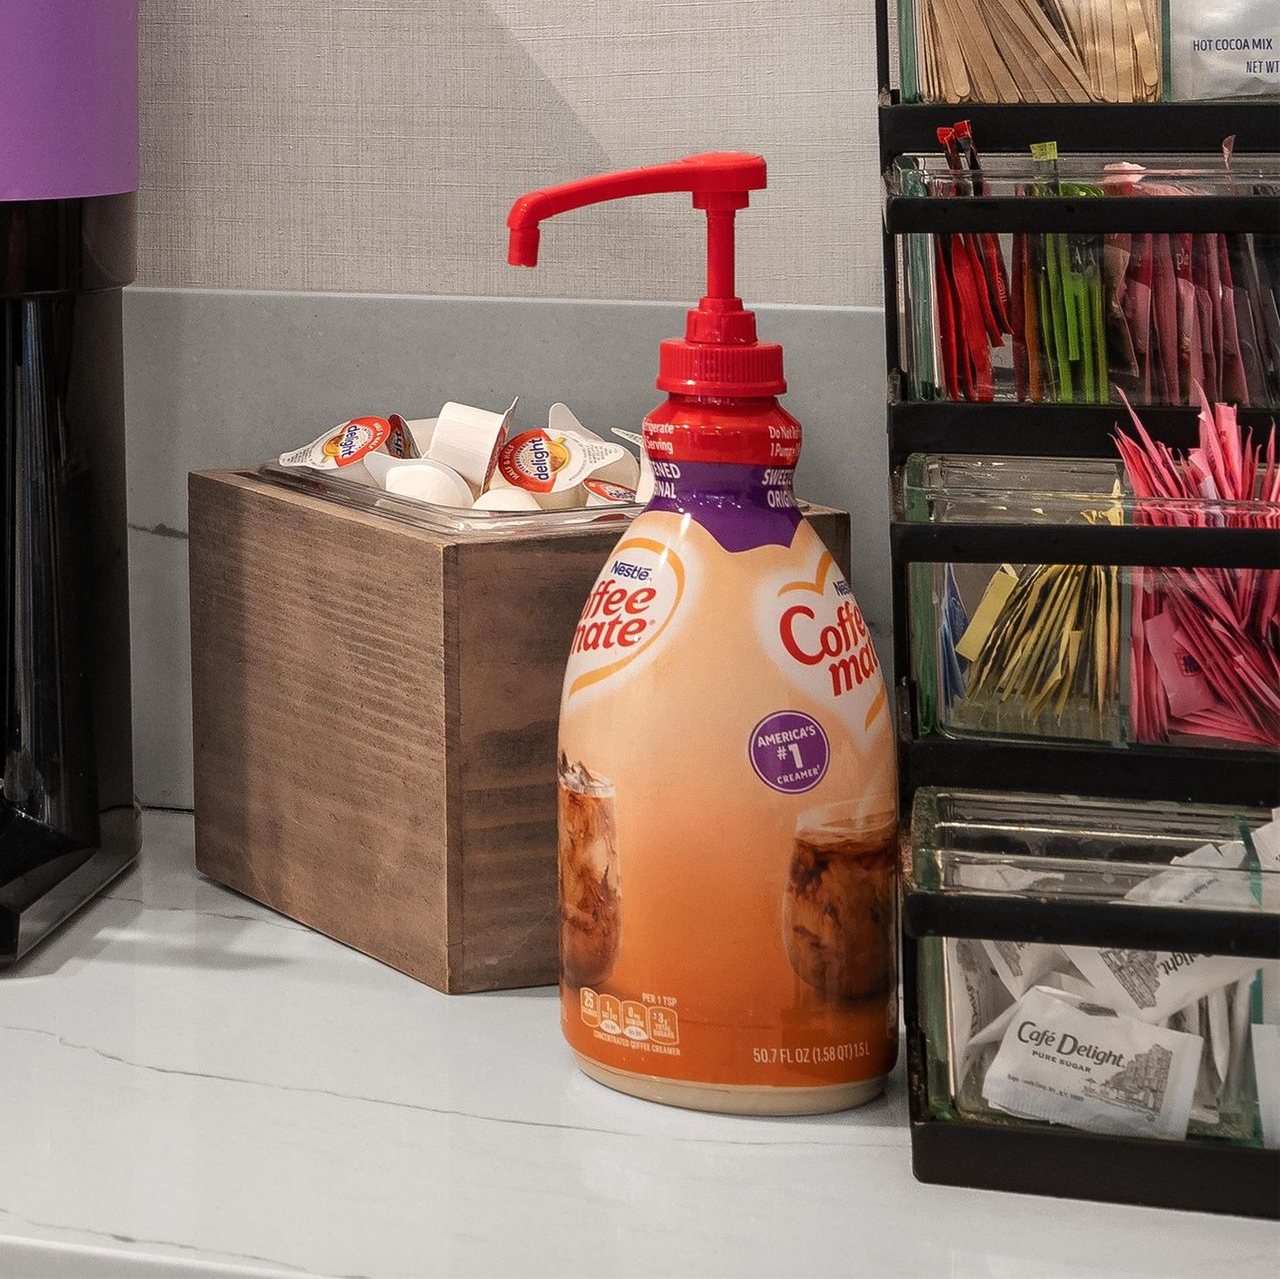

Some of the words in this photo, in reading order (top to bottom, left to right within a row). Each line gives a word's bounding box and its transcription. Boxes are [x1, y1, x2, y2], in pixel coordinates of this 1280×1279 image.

[1192, 39, 1214, 52] HOT
[1215, 38, 1250, 51] COCOA
[1252, 38, 1273, 50] MIX
[1245, 60, 1264, 74] NET
[1265, 60, 1280, 74] WT
[528, 437, 549, 481] delight
[779, 600, 866, 666] Coffe
[829, 636, 879, 697] mat
[757, 725, 817, 748] AMERICA'S
[776, 743, 804, 770] #1
[642, 992, 656, 1004] PER
[662, 996, 677, 1008] TSP
[651, 1045, 681, 1057] CREAMER
[752, 1047, 777, 1063] 50.7
[780, 1048, 794, 1063] FL
[795, 1048, 811, 1063] OZ
[812, 1045, 836, 1065] (1.58
[837, 1043, 853, 1061] QT)
[1017, 1021, 1056, 1047] Café
[1056, 1033, 1124, 1068] Delight
[1031, 1050, 1057, 1064] PURE
[1059, 1059, 1092, 1074] SUGAR
